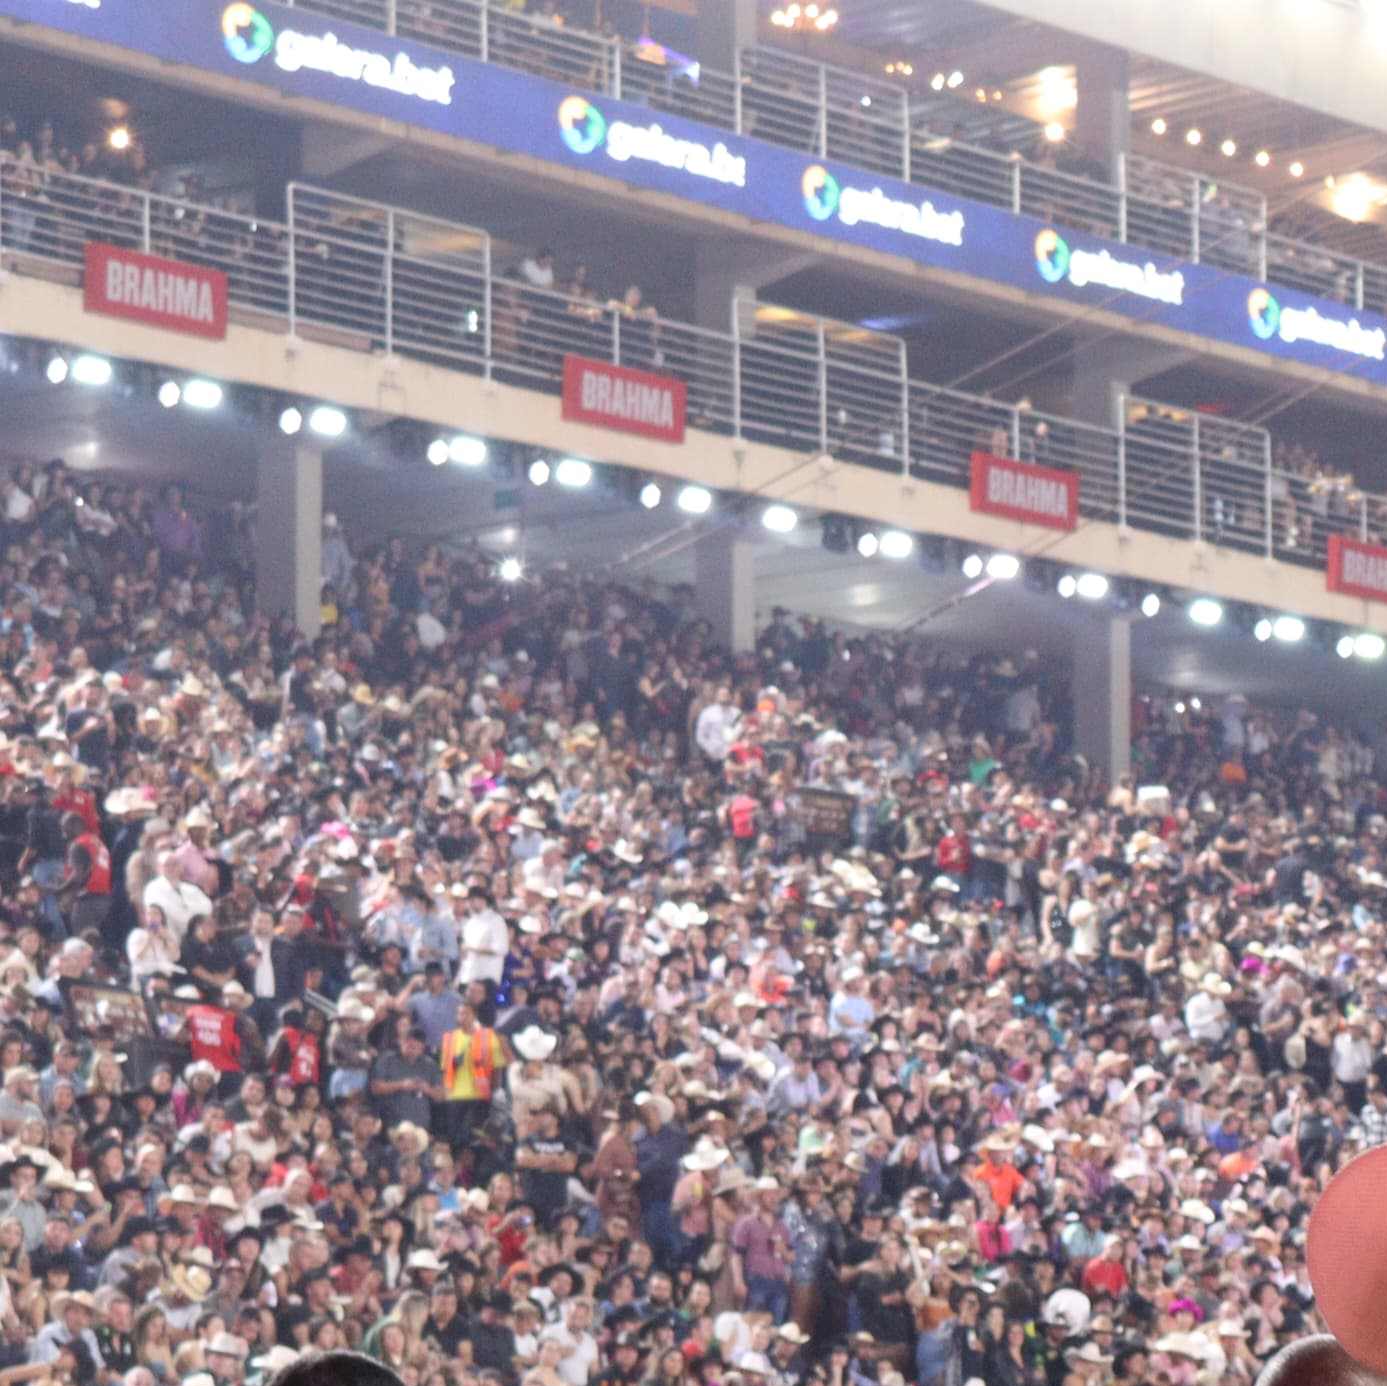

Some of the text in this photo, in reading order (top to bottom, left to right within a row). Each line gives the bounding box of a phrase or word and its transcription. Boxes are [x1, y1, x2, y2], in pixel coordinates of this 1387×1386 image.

[105, 258, 215, 324] BRAHMA
[580, 370, 674, 428] BRAHMA
[988, 467, 1068, 518] BRAHMA
